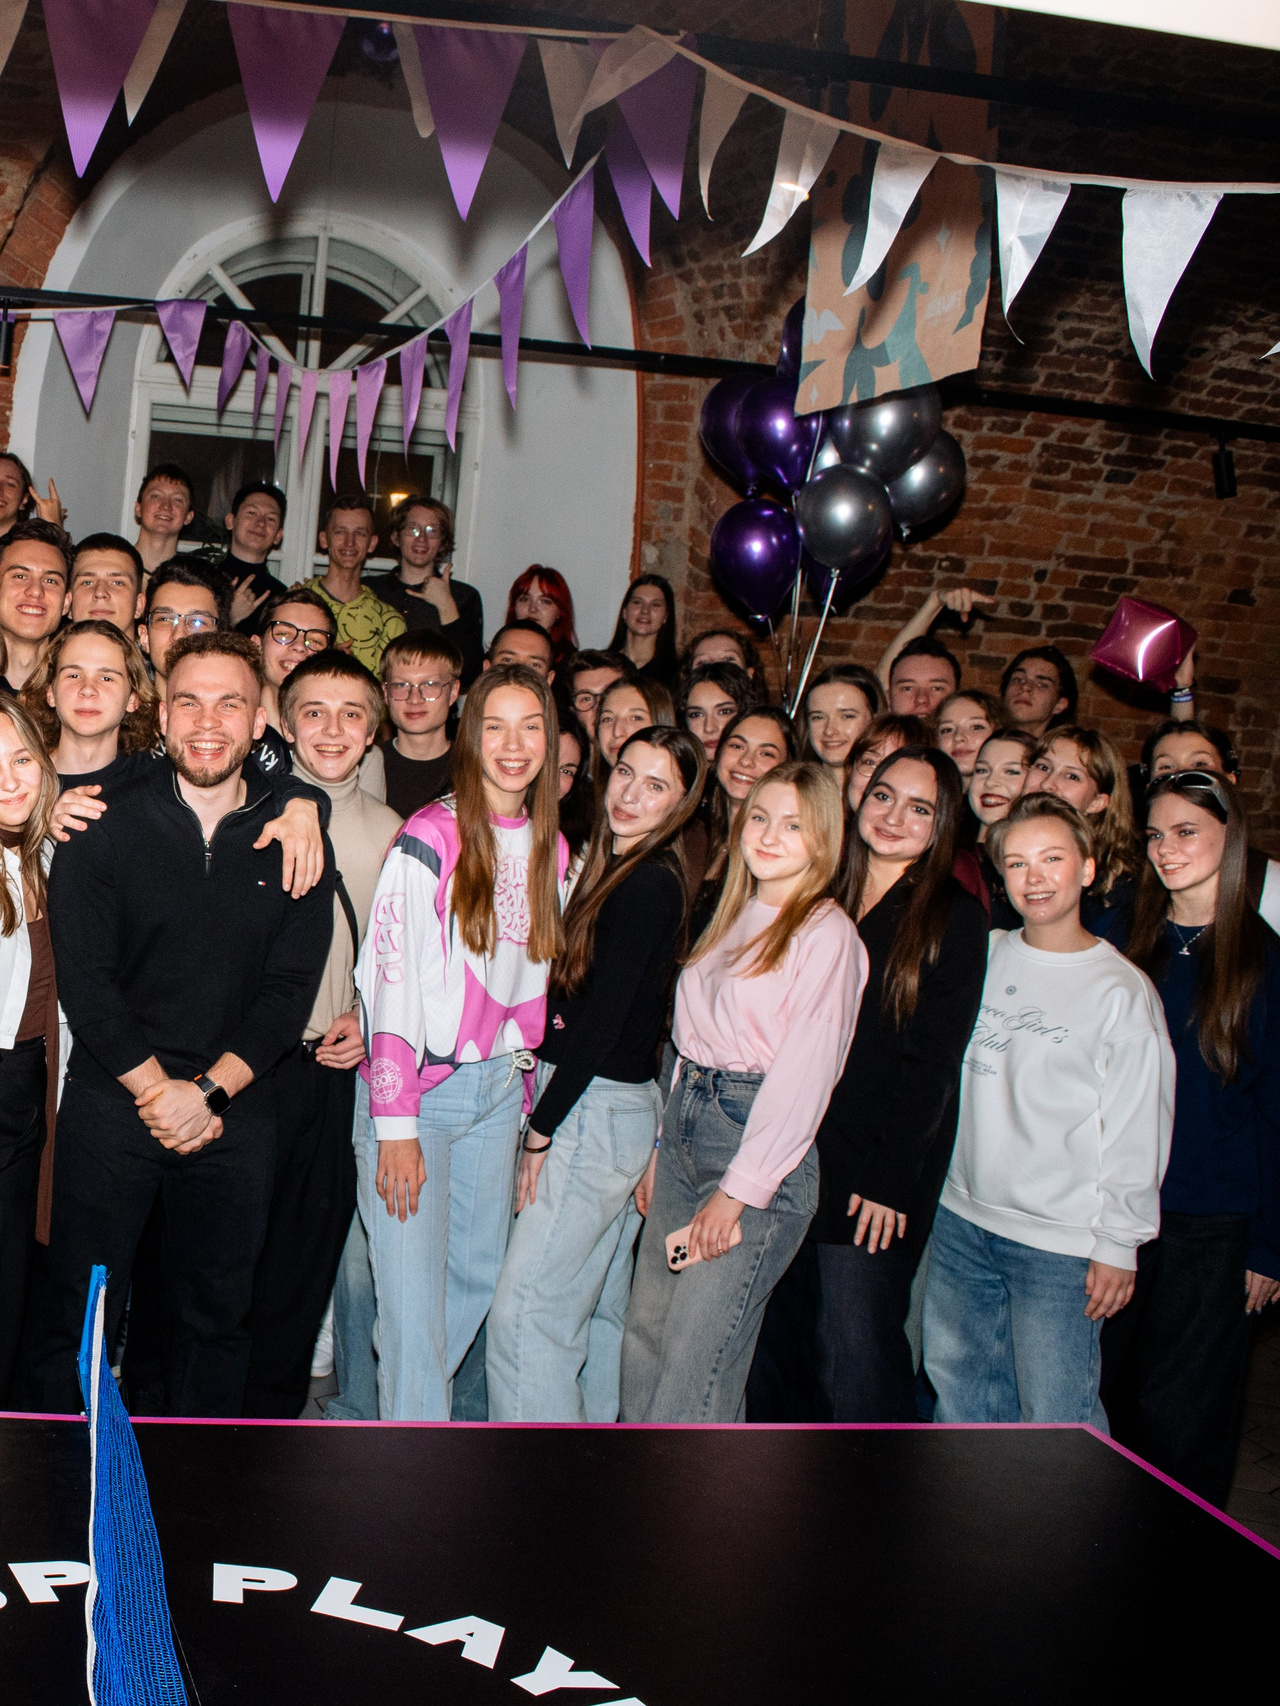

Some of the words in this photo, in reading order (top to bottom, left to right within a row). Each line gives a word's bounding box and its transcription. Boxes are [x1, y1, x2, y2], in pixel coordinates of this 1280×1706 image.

[970, 1019, 1013, 1053] Club
[1002, 1006, 1070, 1044] Girl's
[213, 1562, 648, 1706] PLAY
